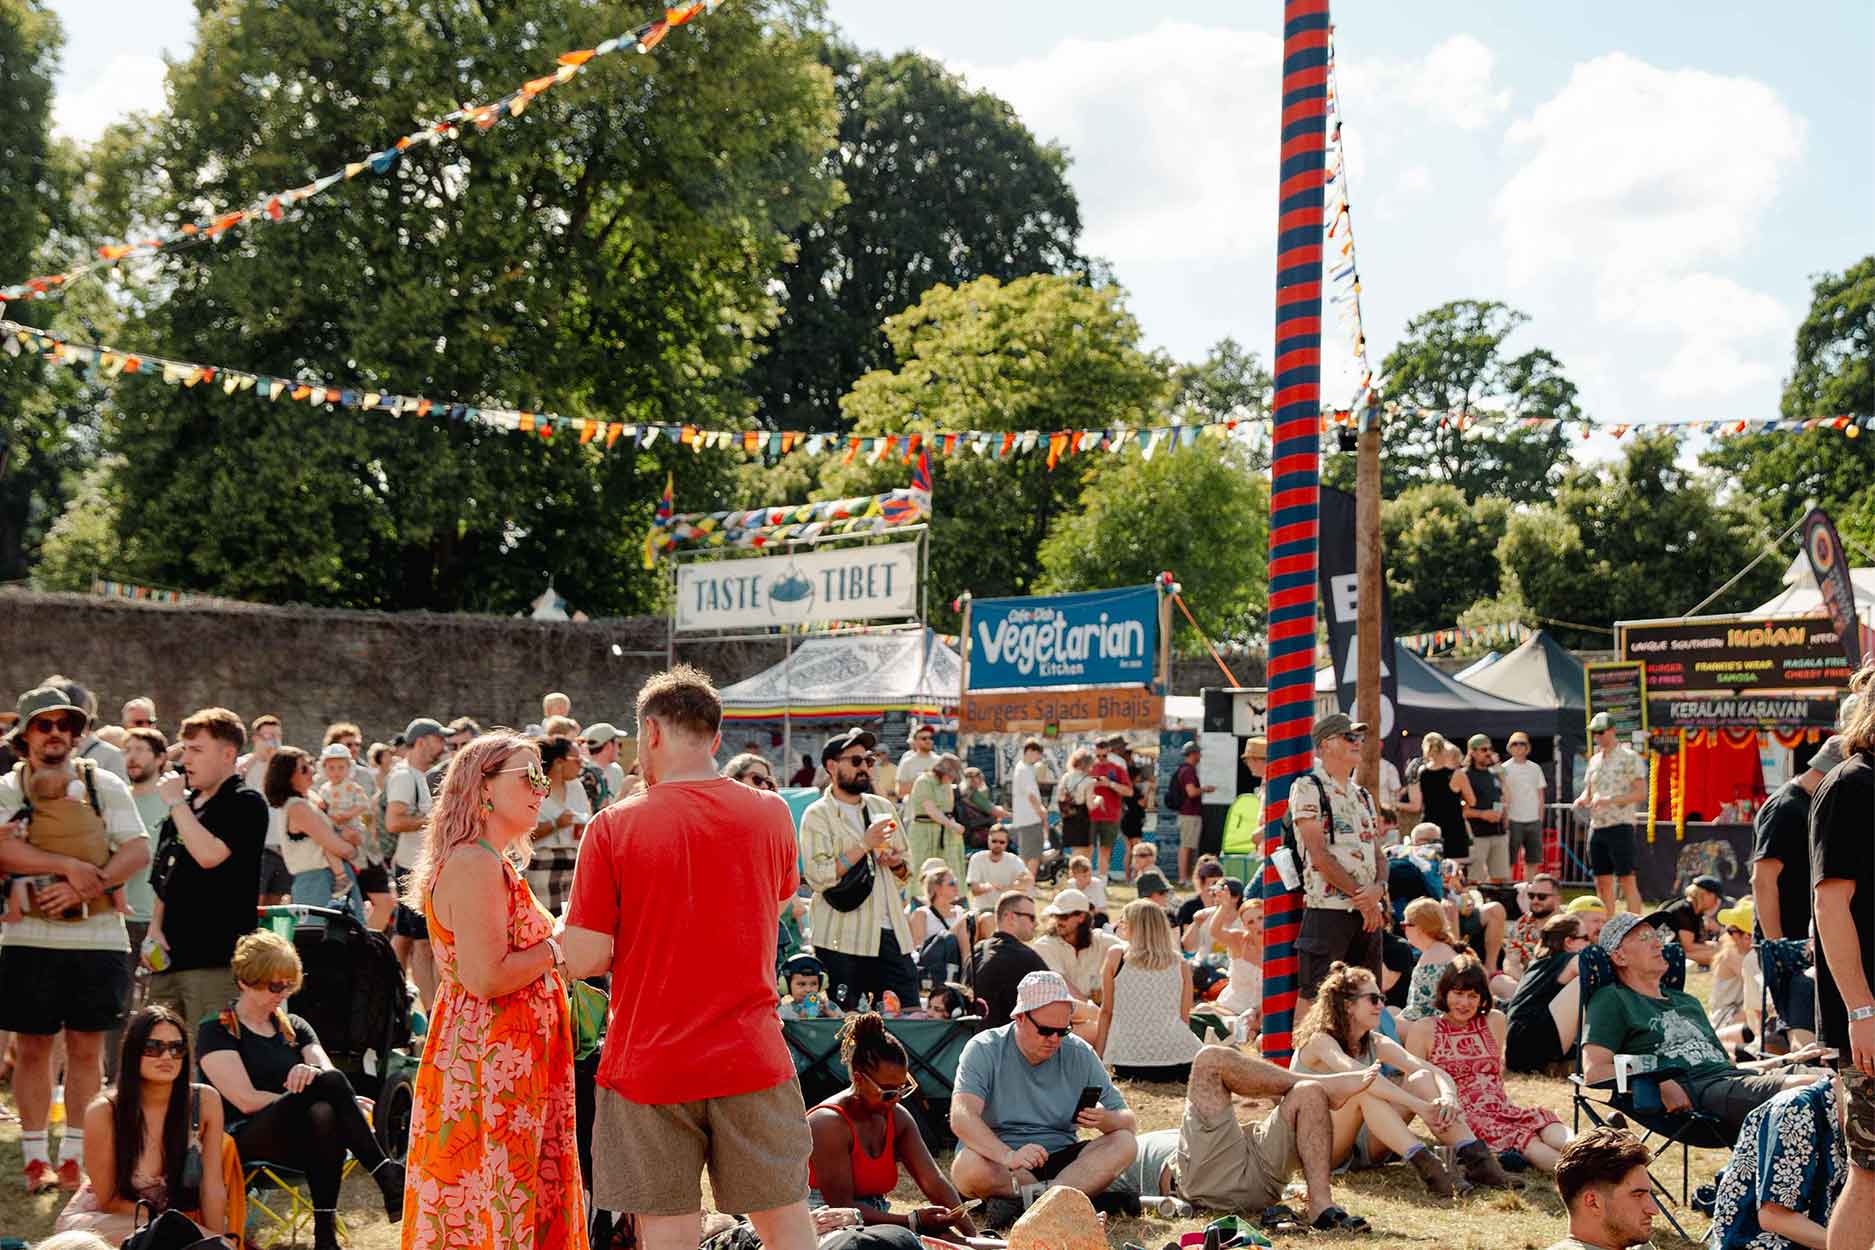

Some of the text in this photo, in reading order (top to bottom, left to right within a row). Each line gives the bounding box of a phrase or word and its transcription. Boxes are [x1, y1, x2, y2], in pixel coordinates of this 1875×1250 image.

[693, 562, 897, 612] TASTE TIBET
[978, 611, 1144, 675] Vegetarian
[1039, 661, 1084, 677] Kitchen
[967, 694, 1149, 732] Burgers Salads Bhajis
[1670, 701, 1809, 718] KERALAN KARAVAN
